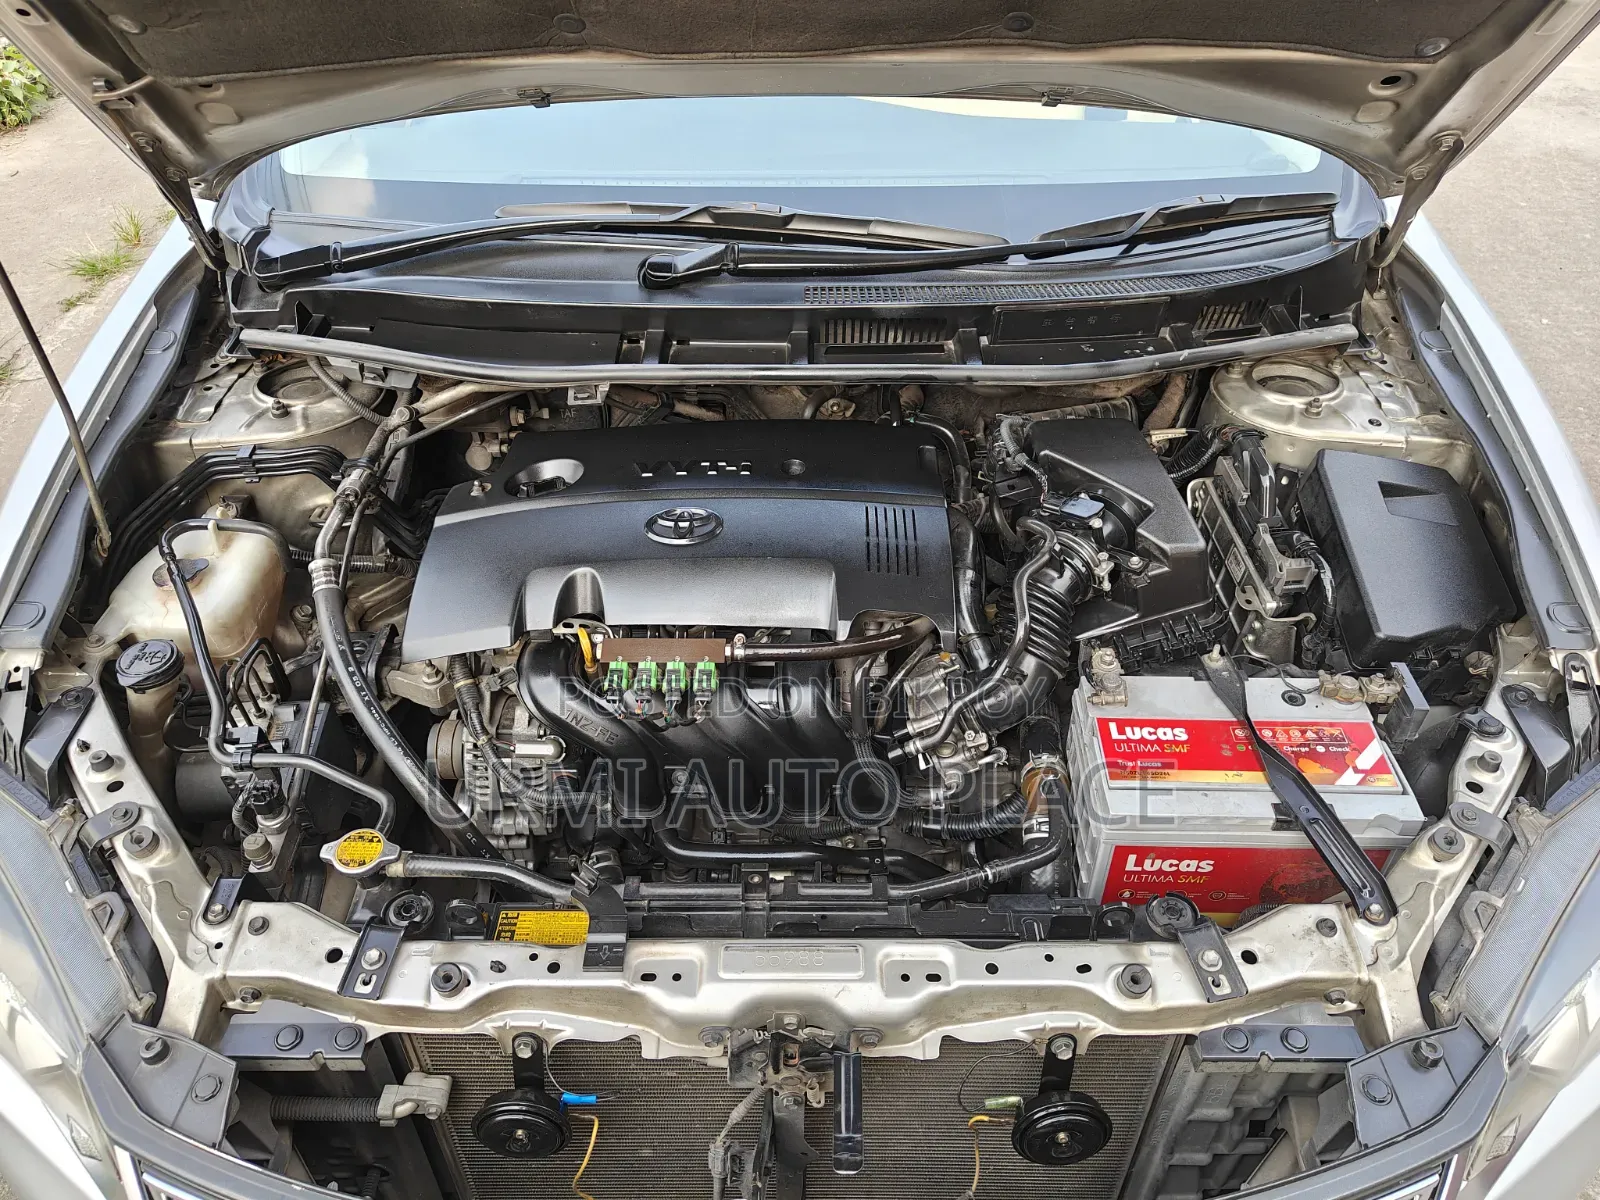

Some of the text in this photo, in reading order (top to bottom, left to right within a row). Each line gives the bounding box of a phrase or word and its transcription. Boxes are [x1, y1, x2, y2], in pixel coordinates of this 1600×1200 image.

[564, 709, 619, 745] 1NZ-FE
[1108, 721, 1189, 741] Lucas
[1113, 743, 1191, 753] ULTIMA SMF
[1125, 853, 1215, 873] Lucas
[1123, 873, 1211, 884] ULTIMA SMF
